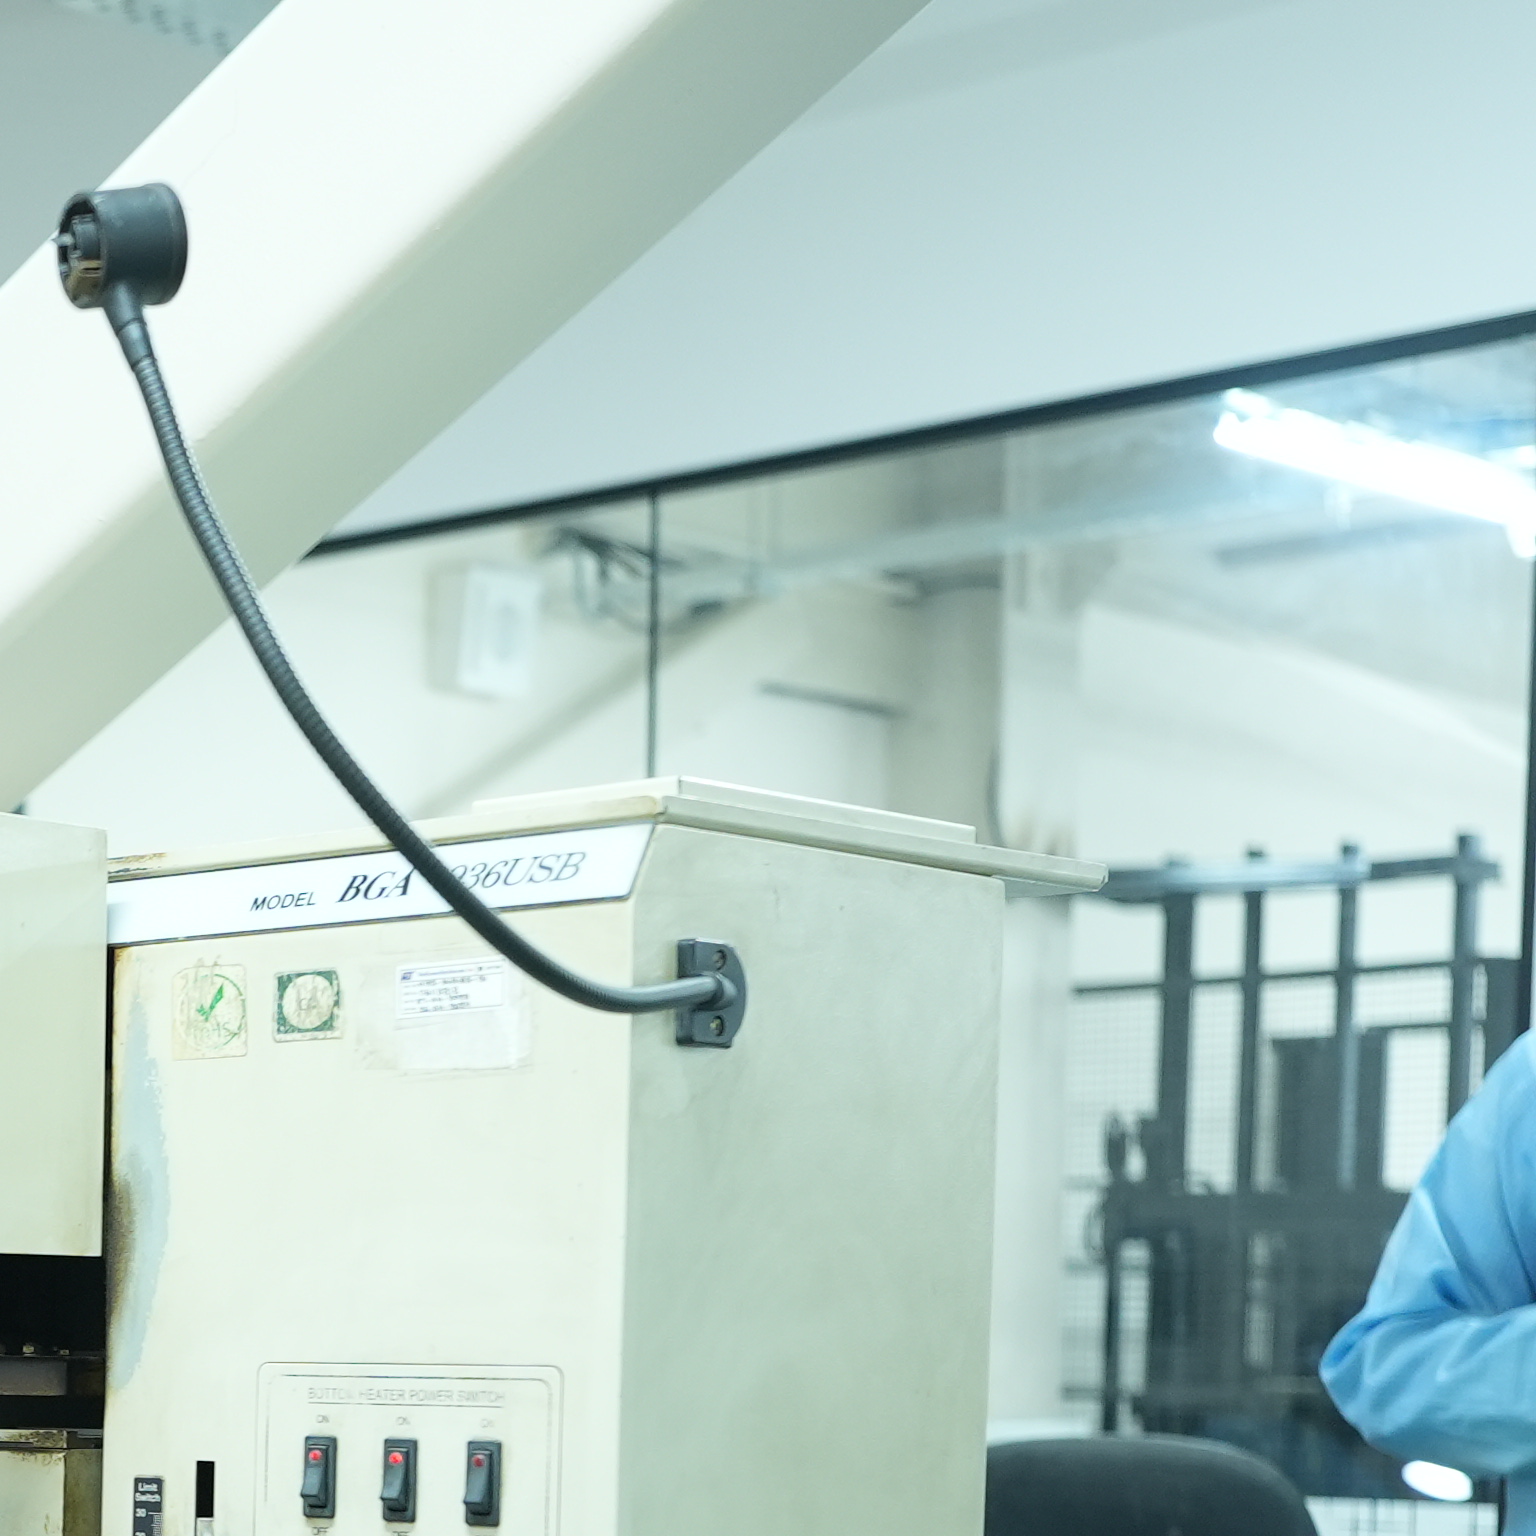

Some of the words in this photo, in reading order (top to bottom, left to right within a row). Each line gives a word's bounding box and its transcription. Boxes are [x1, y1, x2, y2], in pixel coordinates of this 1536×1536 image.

[249, 892, 316, 912] MODEL
[335, 867, 416, 903] BGA
[359, 1388, 406, 1401] HEATER
[409, 1389, 454, 1402] POWER
[457, 1390, 505, 1403] SWITCH
